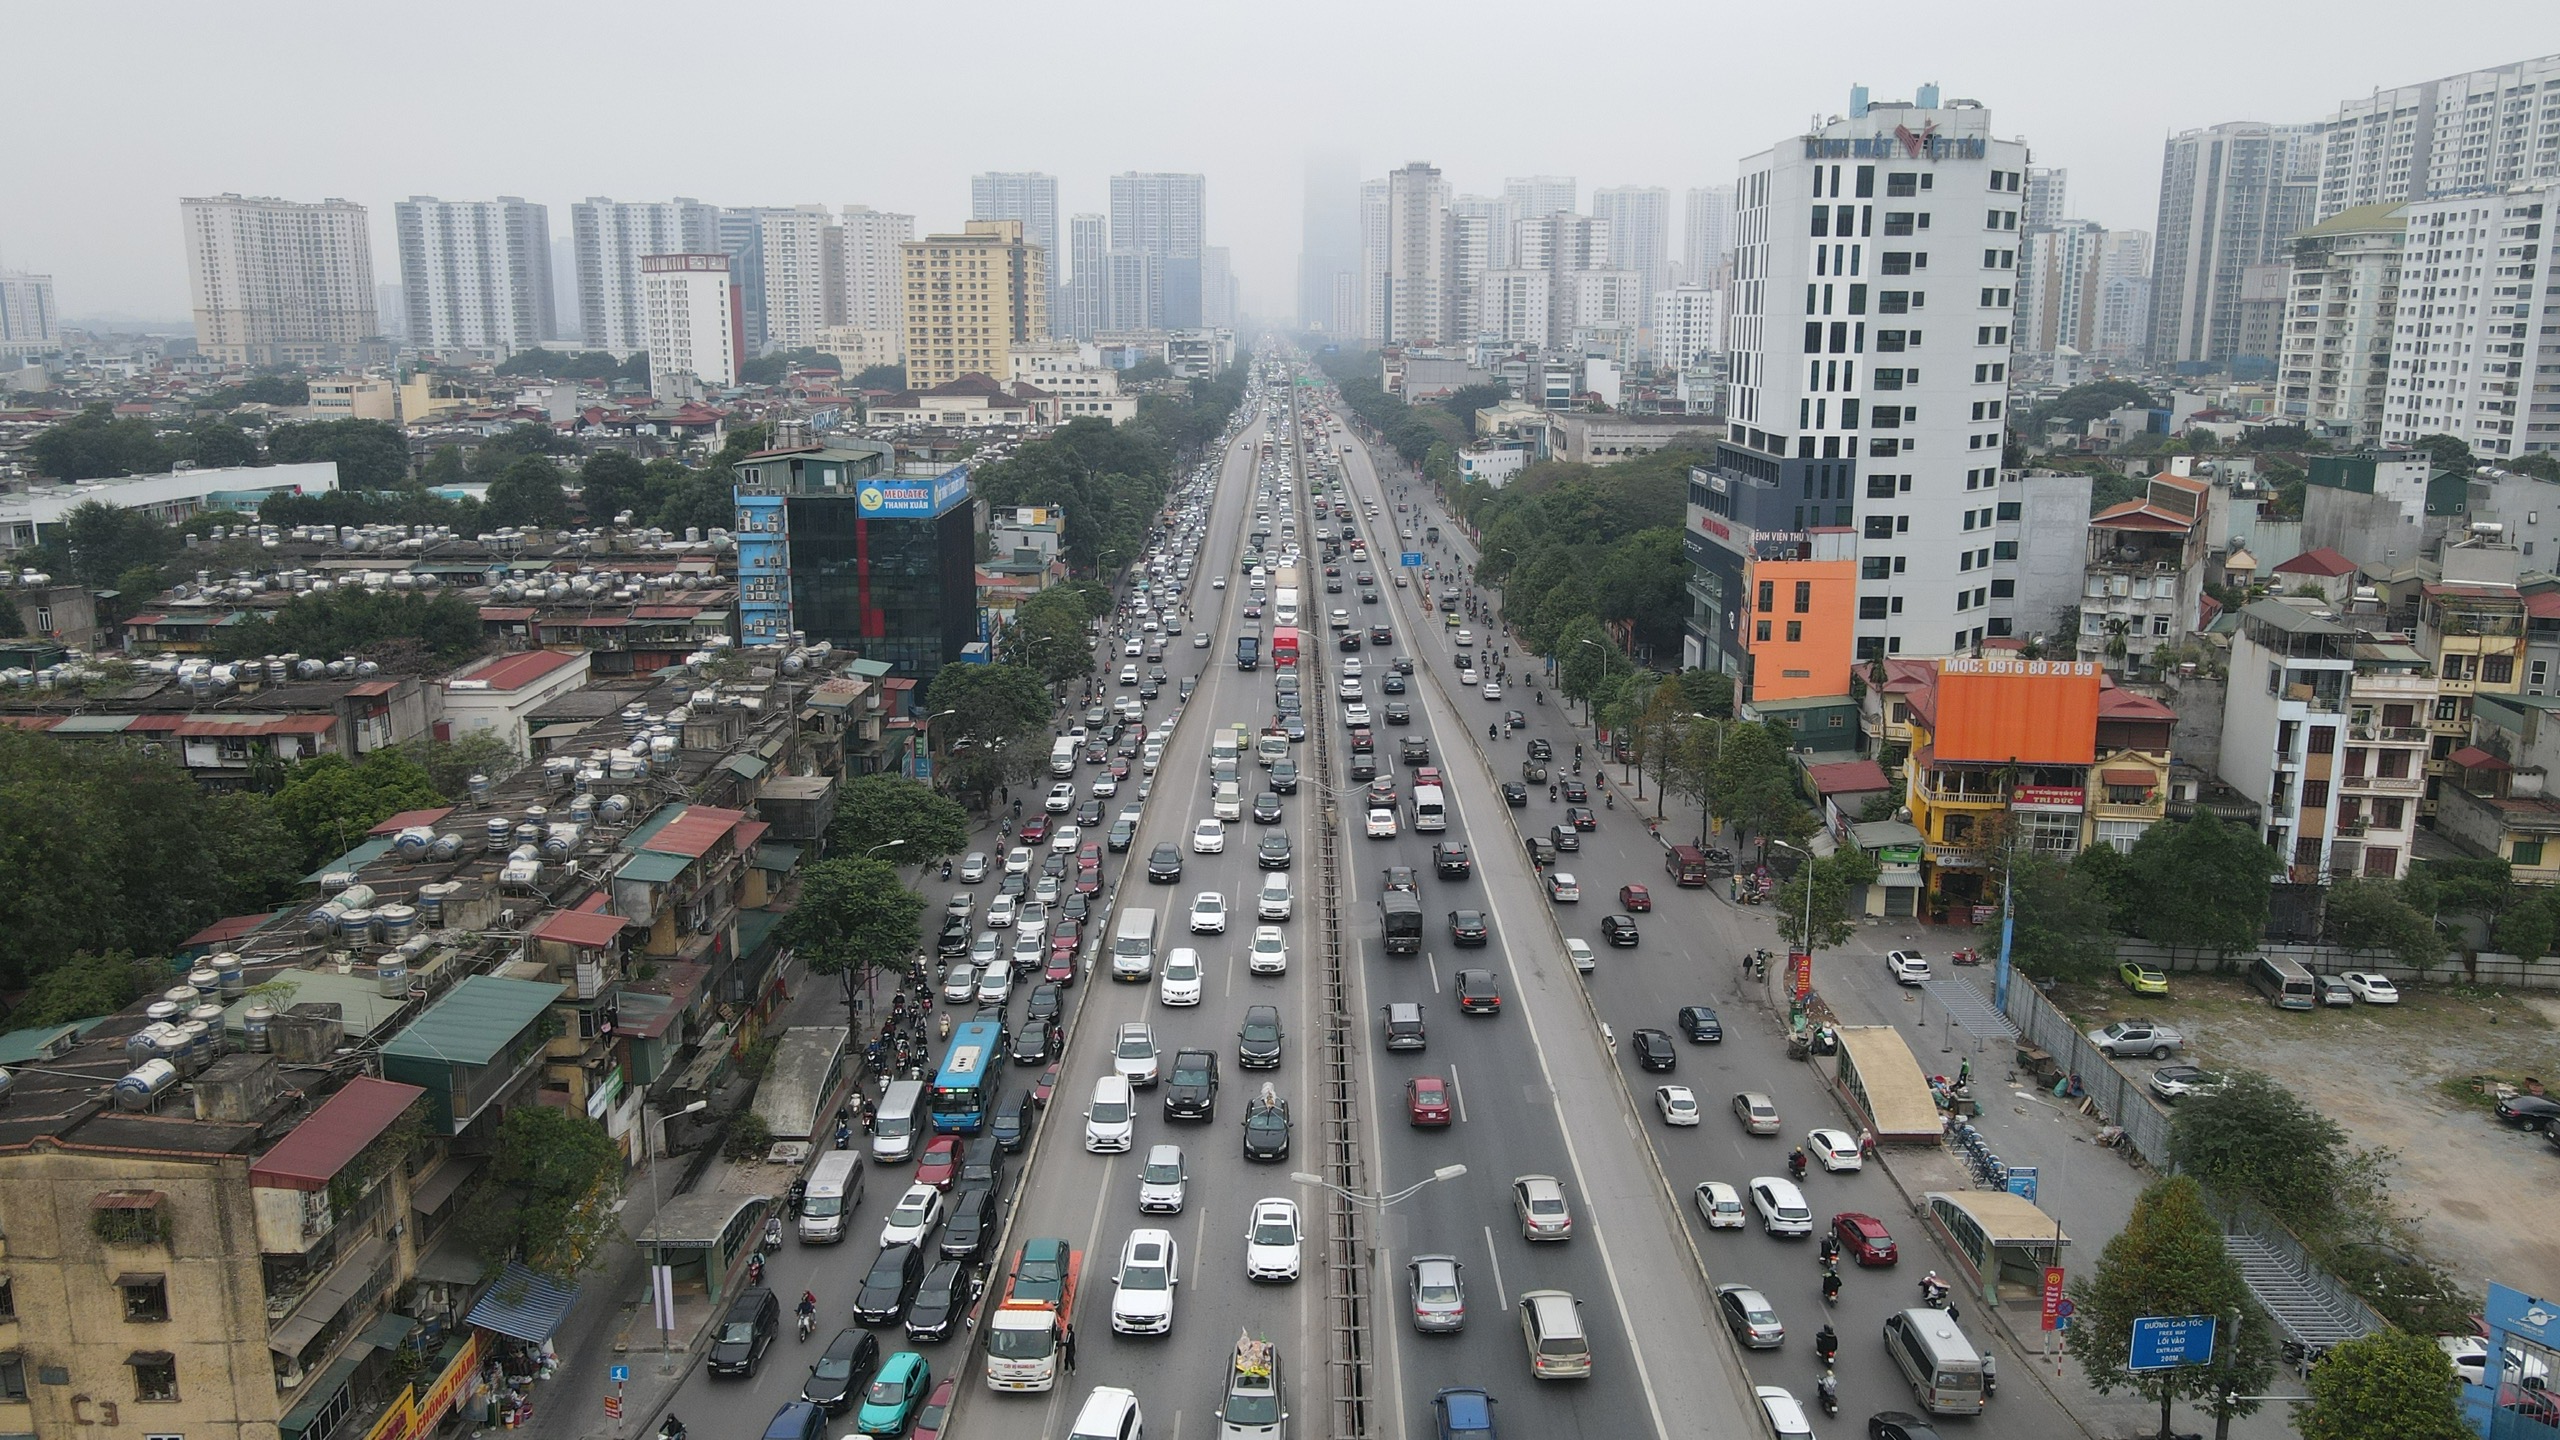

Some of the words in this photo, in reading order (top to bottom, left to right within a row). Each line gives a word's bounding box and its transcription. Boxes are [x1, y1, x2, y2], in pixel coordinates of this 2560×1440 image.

[884, 489, 928, 499] MEDLATEC
[909, 501, 928, 509] XUÂN
[1771, 529, 1788, 544] VIỆN
[1790, 529, 1804, 541] THÚ
[1945, 659, 1983, 673] MQC:
[1988, 661, 2024, 674] 0916
[2028, 662, 2047, 674] 80
[2051, 662, 2070, 675] 20
[2074, 663, 2093, 676] 99
[2188, 1318, 2204, 1327] TỐC
[2155, 1346, 2185, 1354] ENTRANCE
[416, 1385, 449, 1435] CHỐNG
